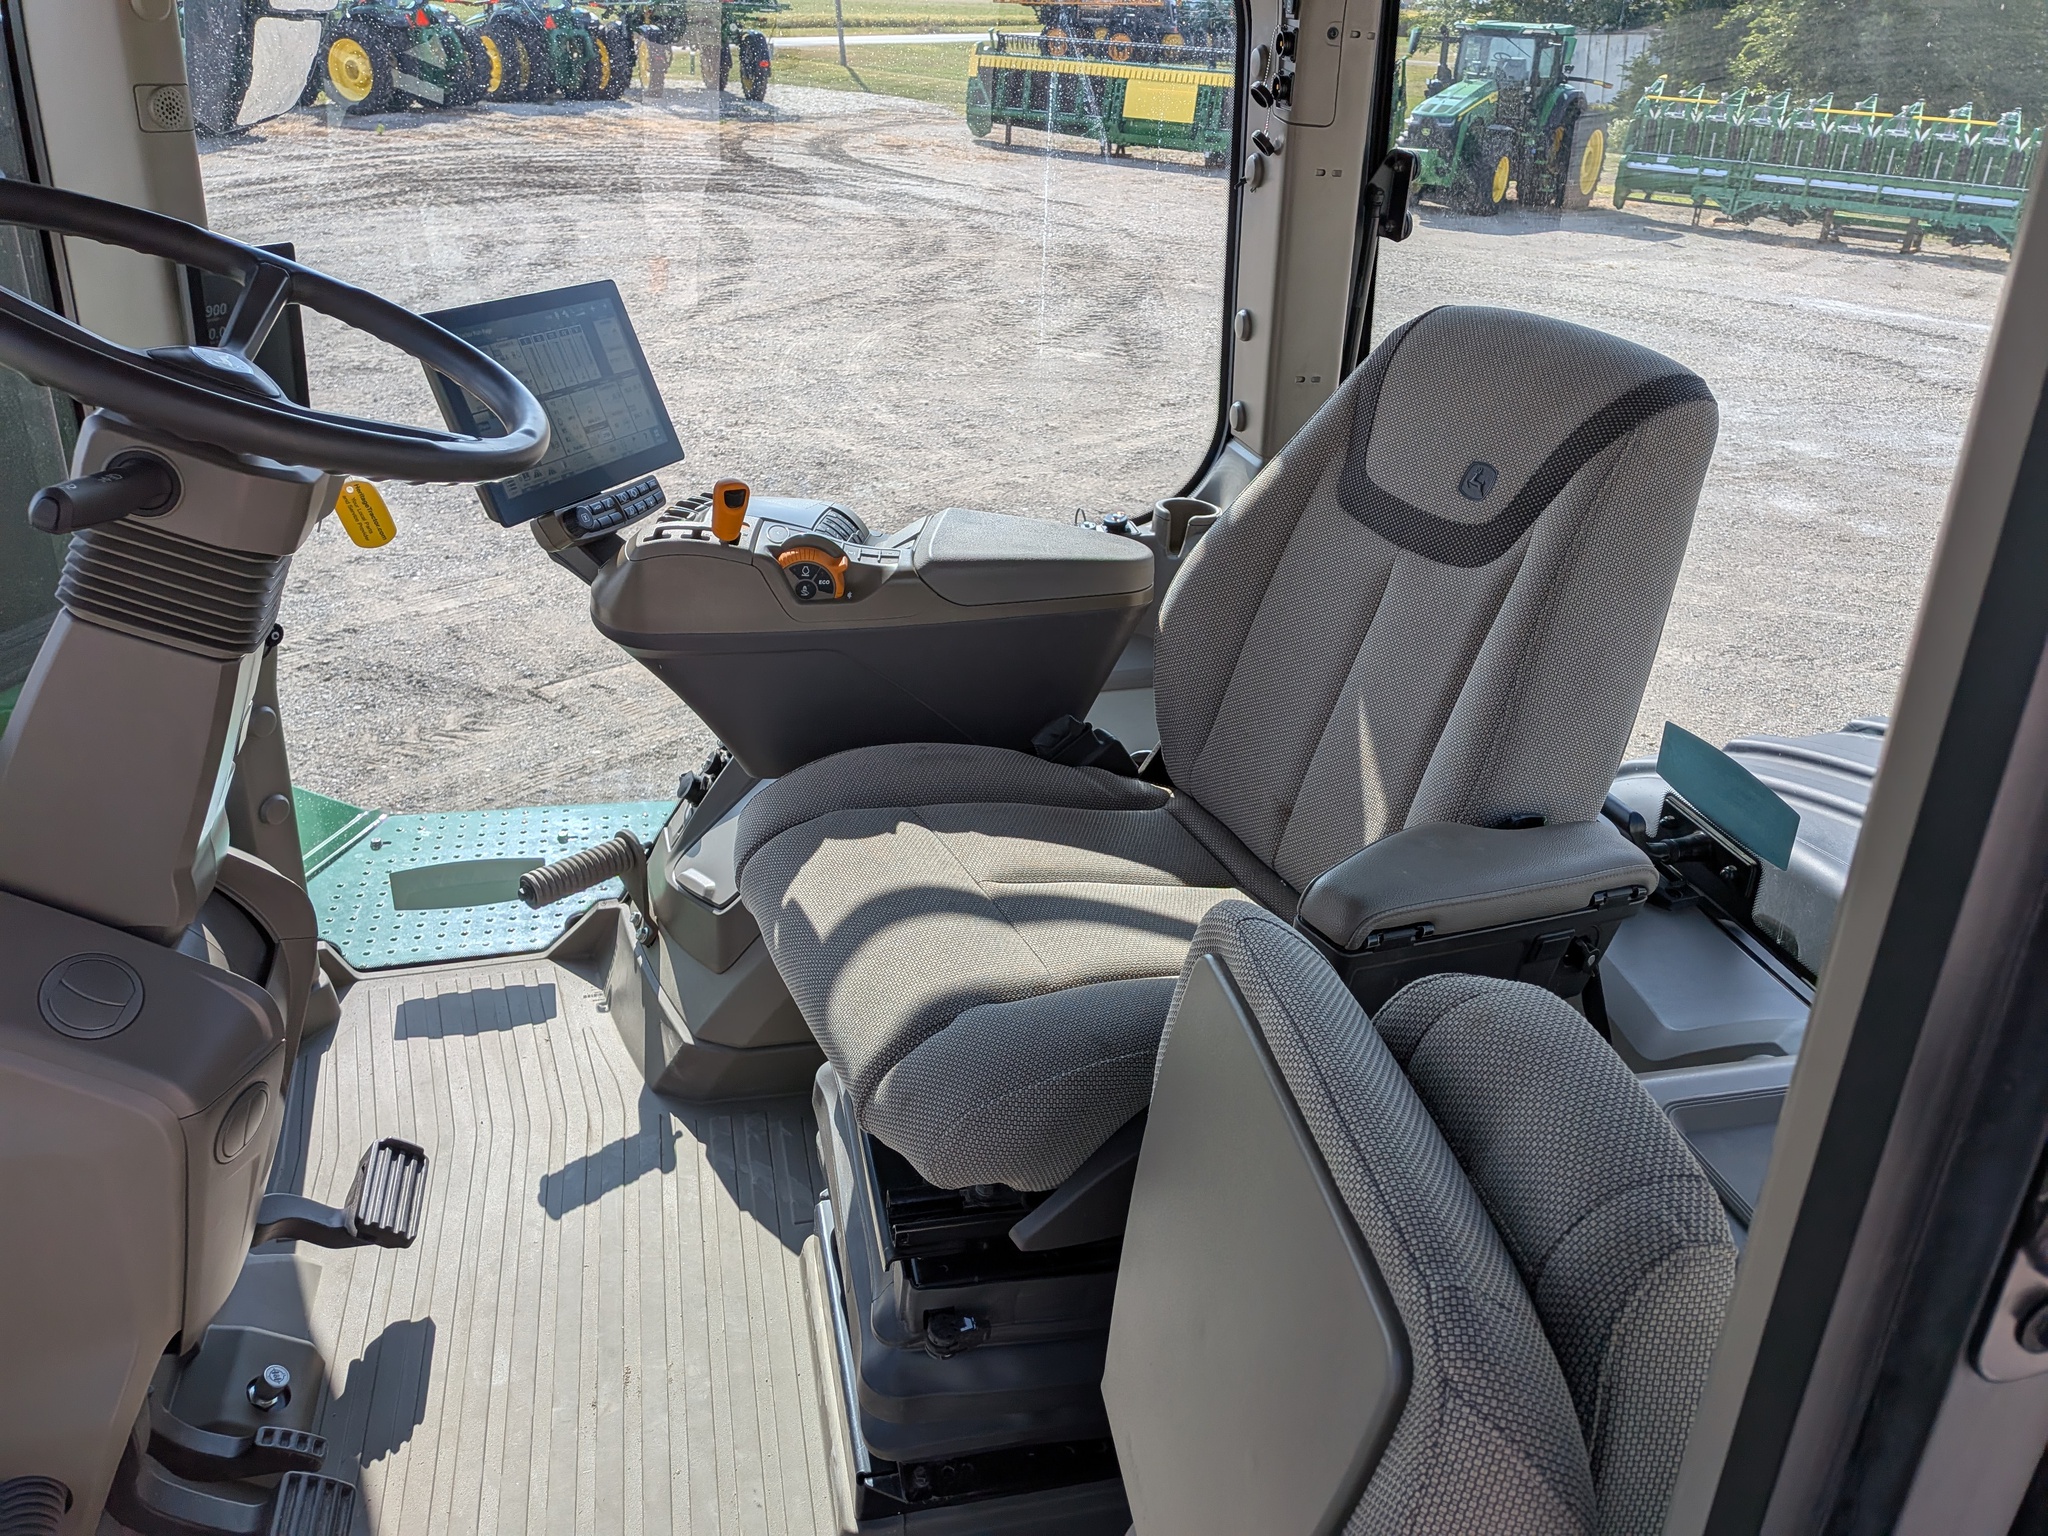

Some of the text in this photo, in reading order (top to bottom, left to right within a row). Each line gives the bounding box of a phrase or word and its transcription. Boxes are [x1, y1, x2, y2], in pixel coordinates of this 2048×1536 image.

[205, 303, 227, 317] 900
[342, 495, 369, 541] and Service Provider
[351, 497, 373, 534] Your Local Parts
[354, 483, 387, 541] HeritageTractor.com
